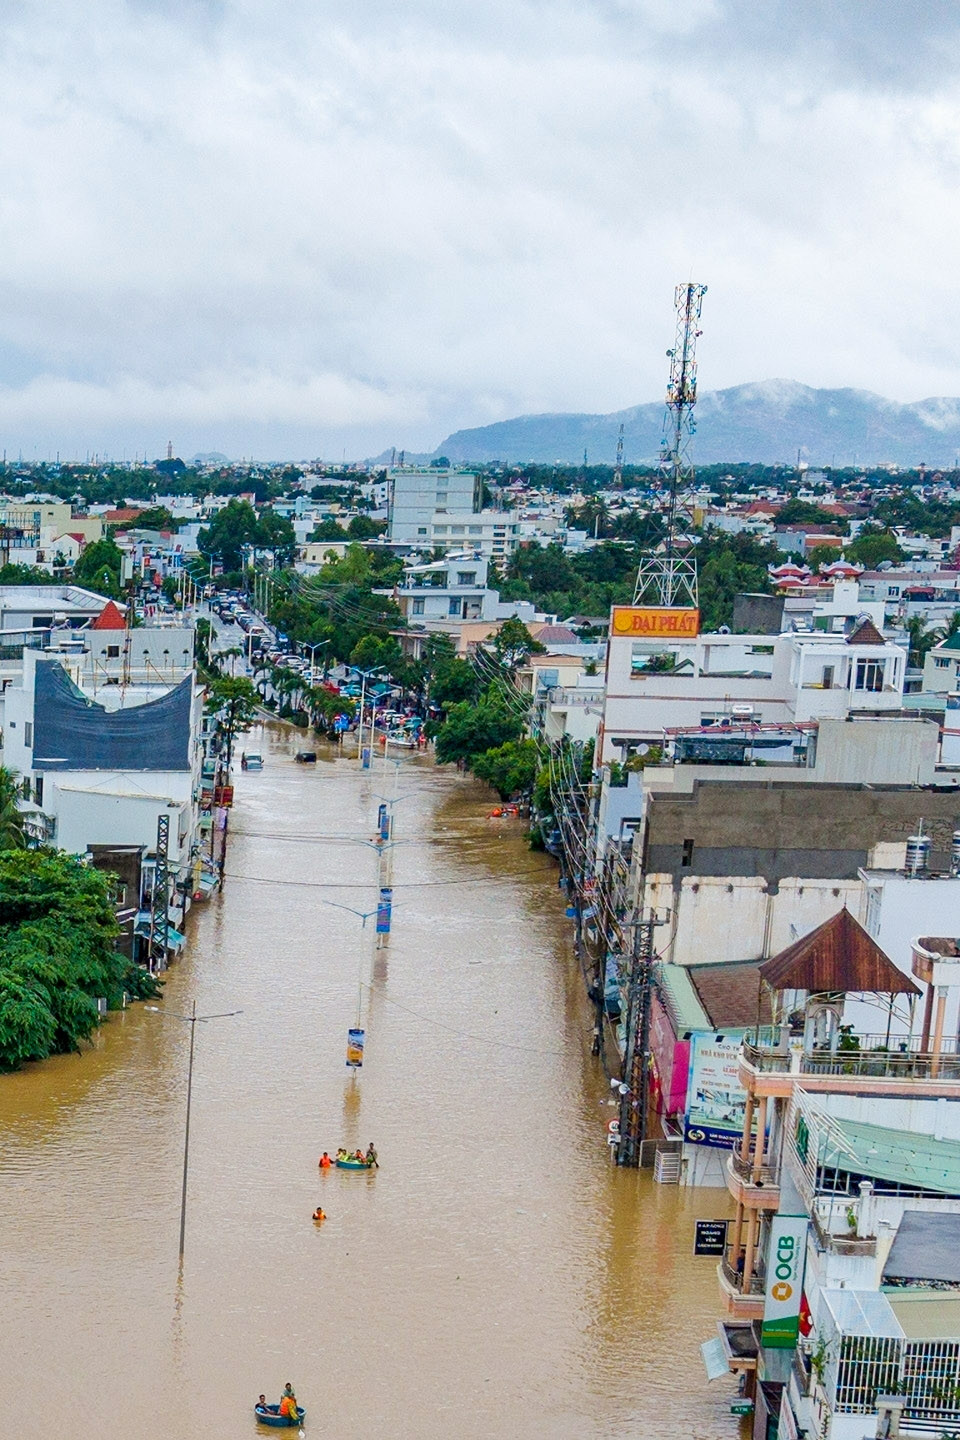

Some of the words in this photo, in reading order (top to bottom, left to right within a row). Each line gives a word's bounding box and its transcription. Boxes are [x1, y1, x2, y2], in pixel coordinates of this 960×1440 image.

[632, 615, 657, 633] ĐẠI
[658, 612, 696, 632] PHÁT
[775, 1236, 795, 1281] OCB
